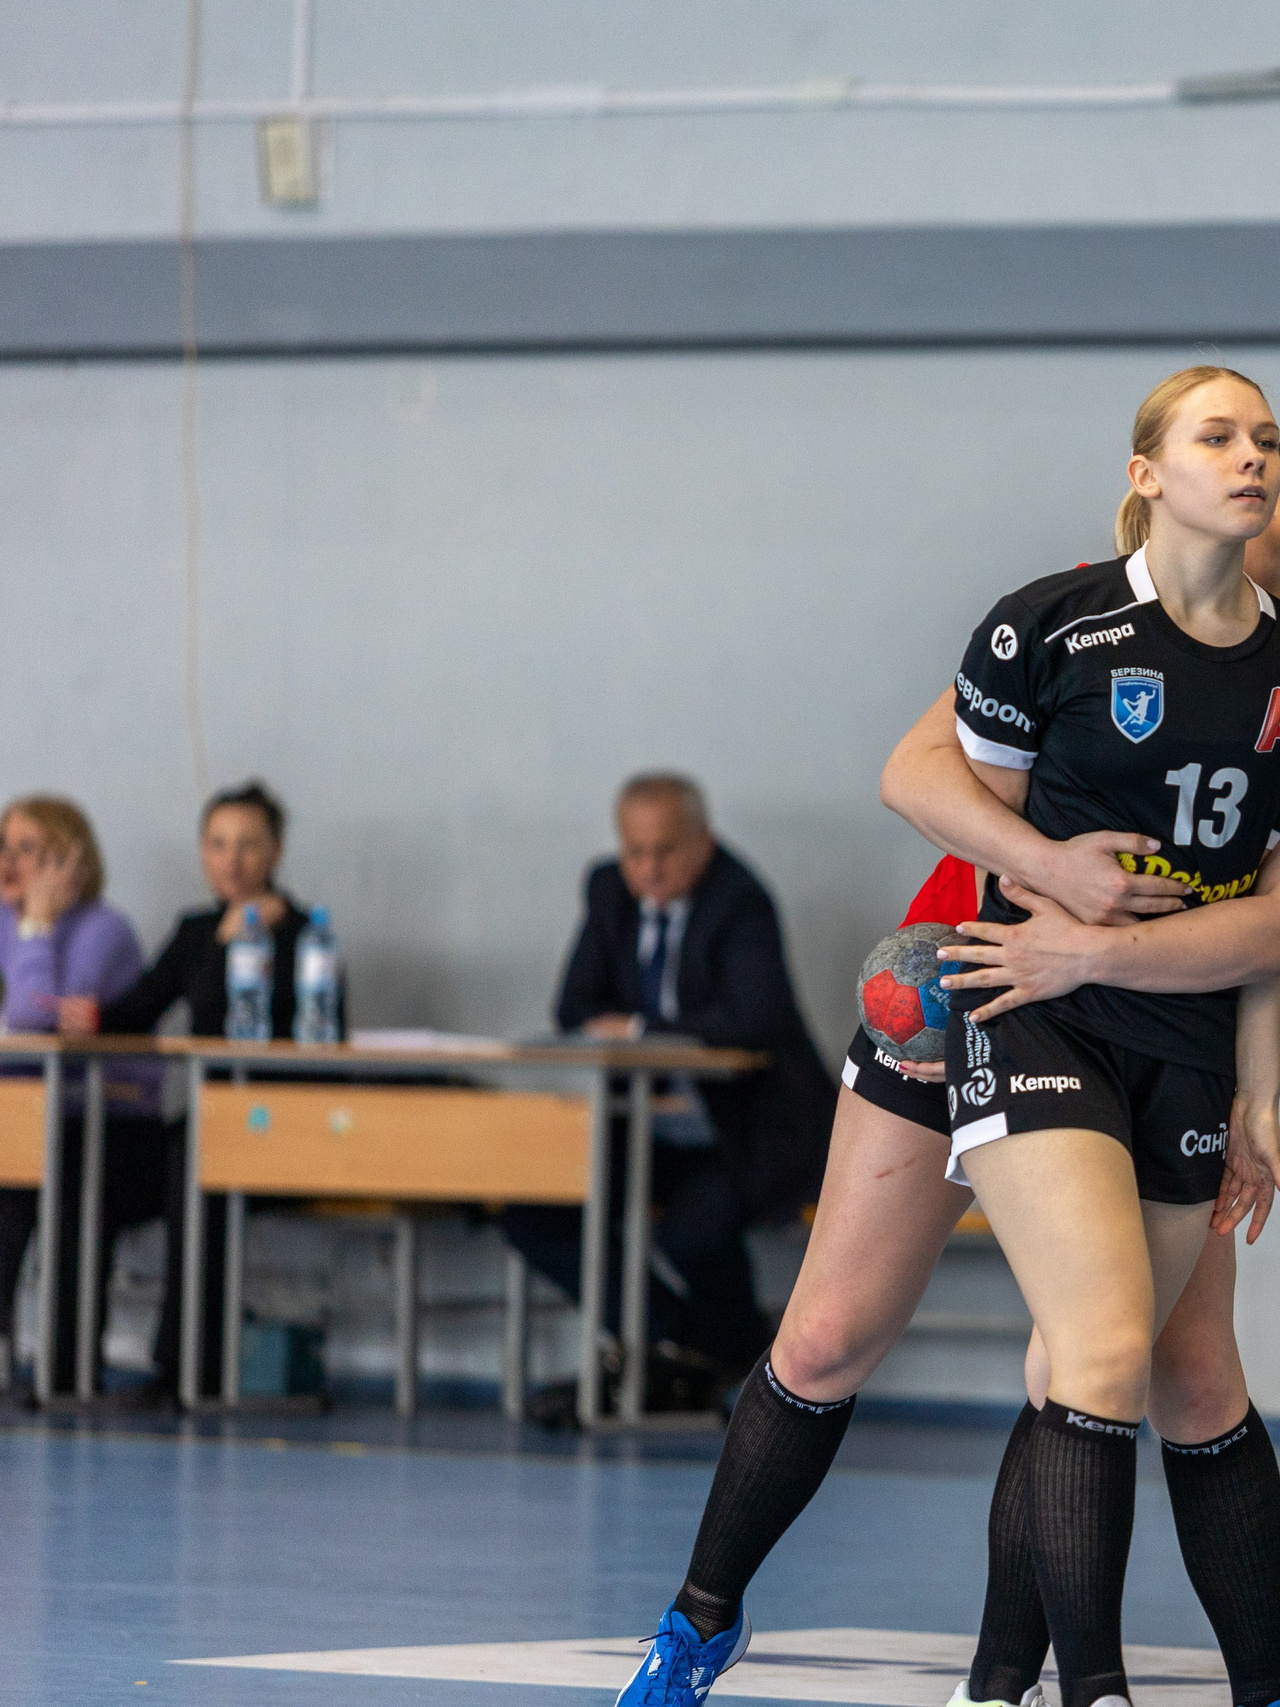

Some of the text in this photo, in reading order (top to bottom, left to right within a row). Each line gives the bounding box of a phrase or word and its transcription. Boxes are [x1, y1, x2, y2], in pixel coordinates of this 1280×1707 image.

[1064, 622, 1136, 655] Kempa
[1110, 667, 1164, 681] БЕРЕЗИНА
[956, 671, 1037, 733] еврооп
[1164, 762, 1249, 849] 13
[963, 1010, 975, 1069] БОБРУЙСКИ
[970, 1021, 983, 1067] МАШИНО
[874, 1047, 928, 1084] Kem
[1010, 1073, 1082, 1094] Kempa
[1066, 1410, 1137, 1441] Kemp
[1163, 1425, 1249, 1456] empa
